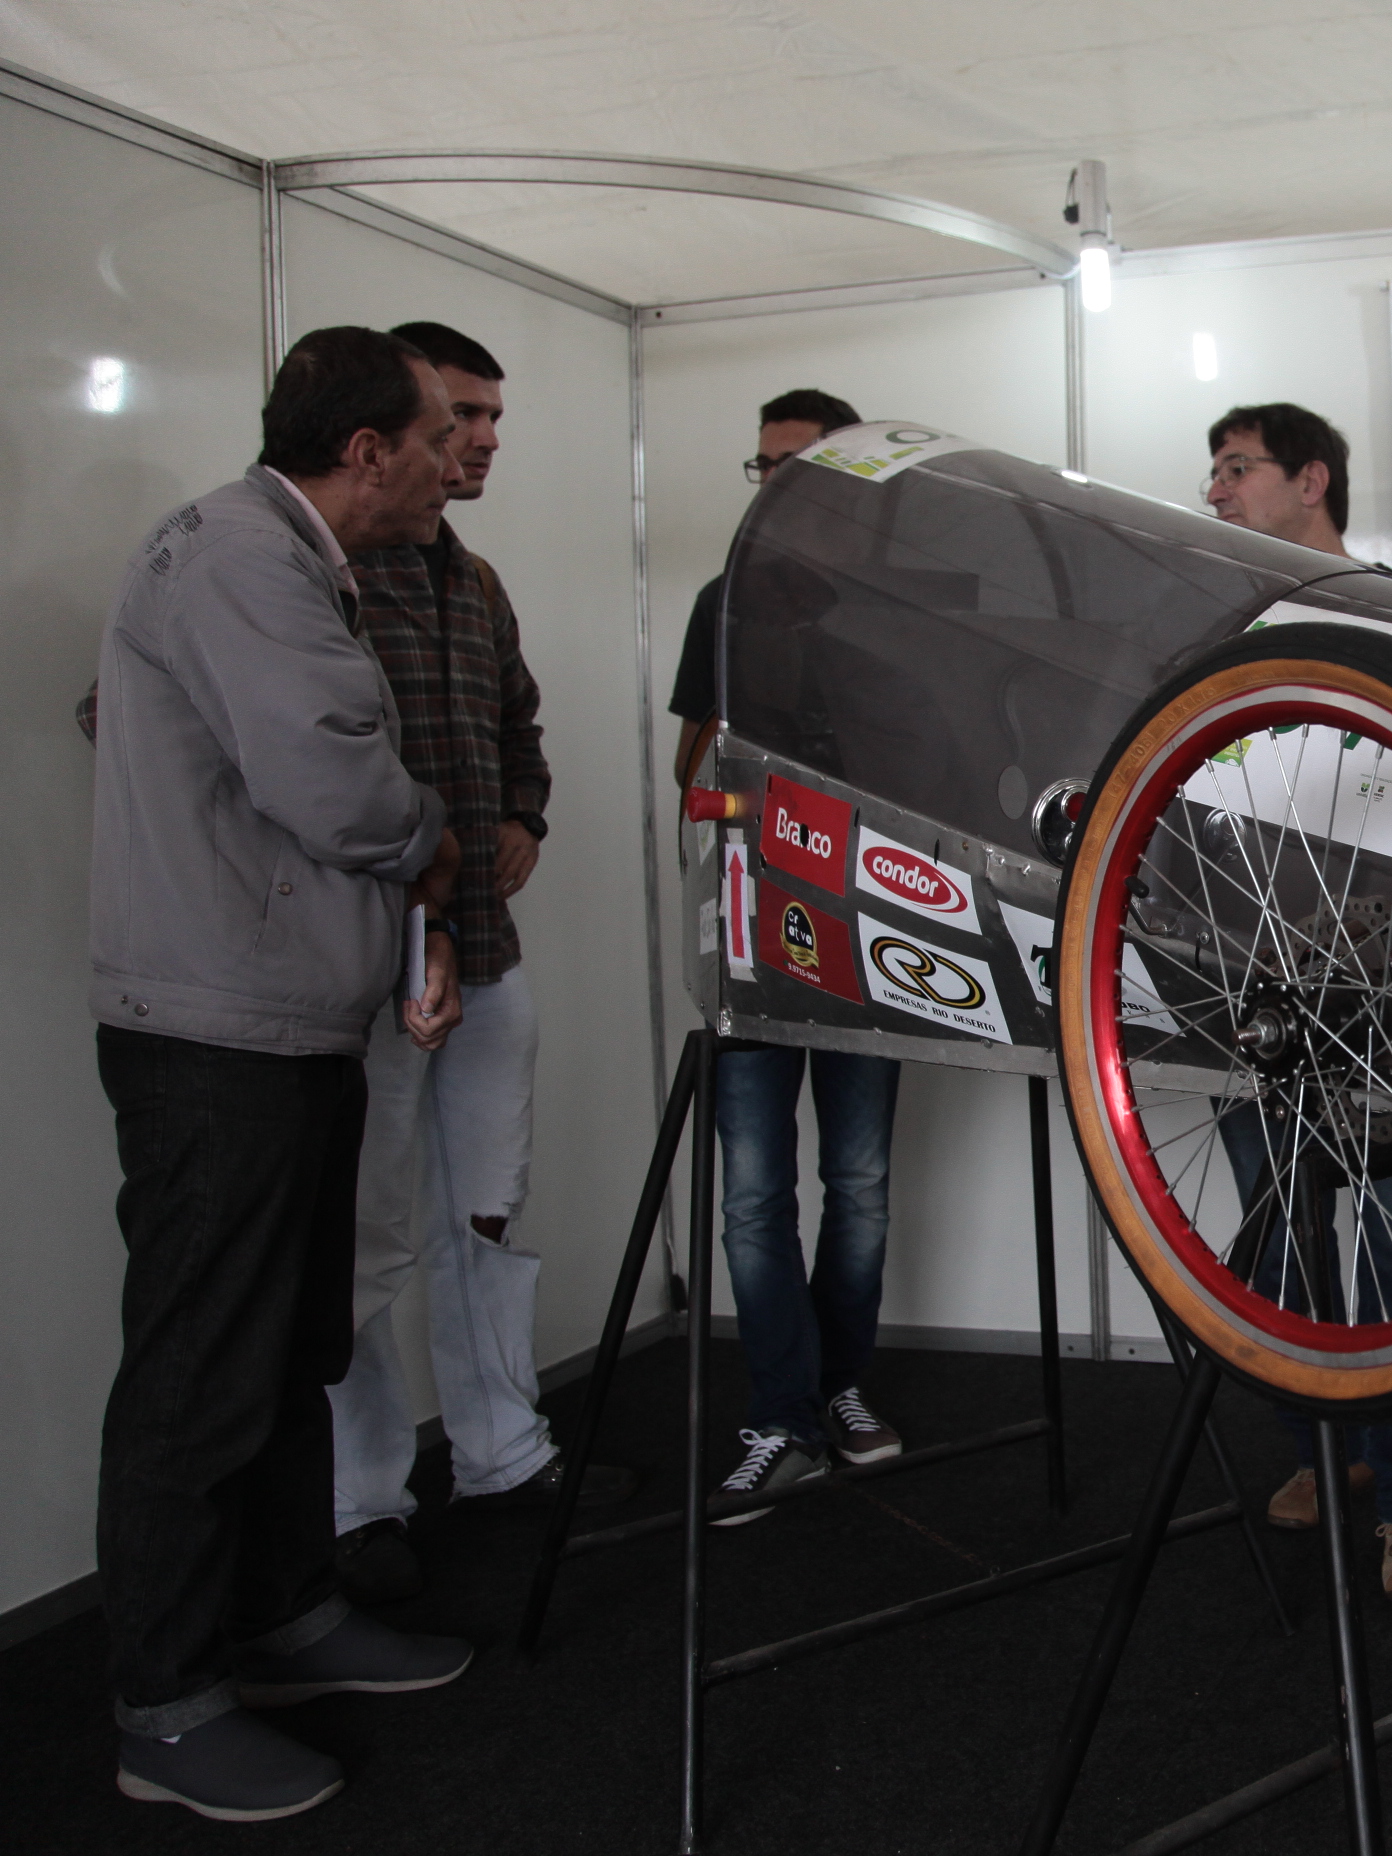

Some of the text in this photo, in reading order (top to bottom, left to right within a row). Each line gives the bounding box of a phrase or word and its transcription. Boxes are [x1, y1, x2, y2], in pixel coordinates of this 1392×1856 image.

[872, 855, 939, 898] condor
[883, 989, 996, 1033] EMPRESAS RIO DESERTO
